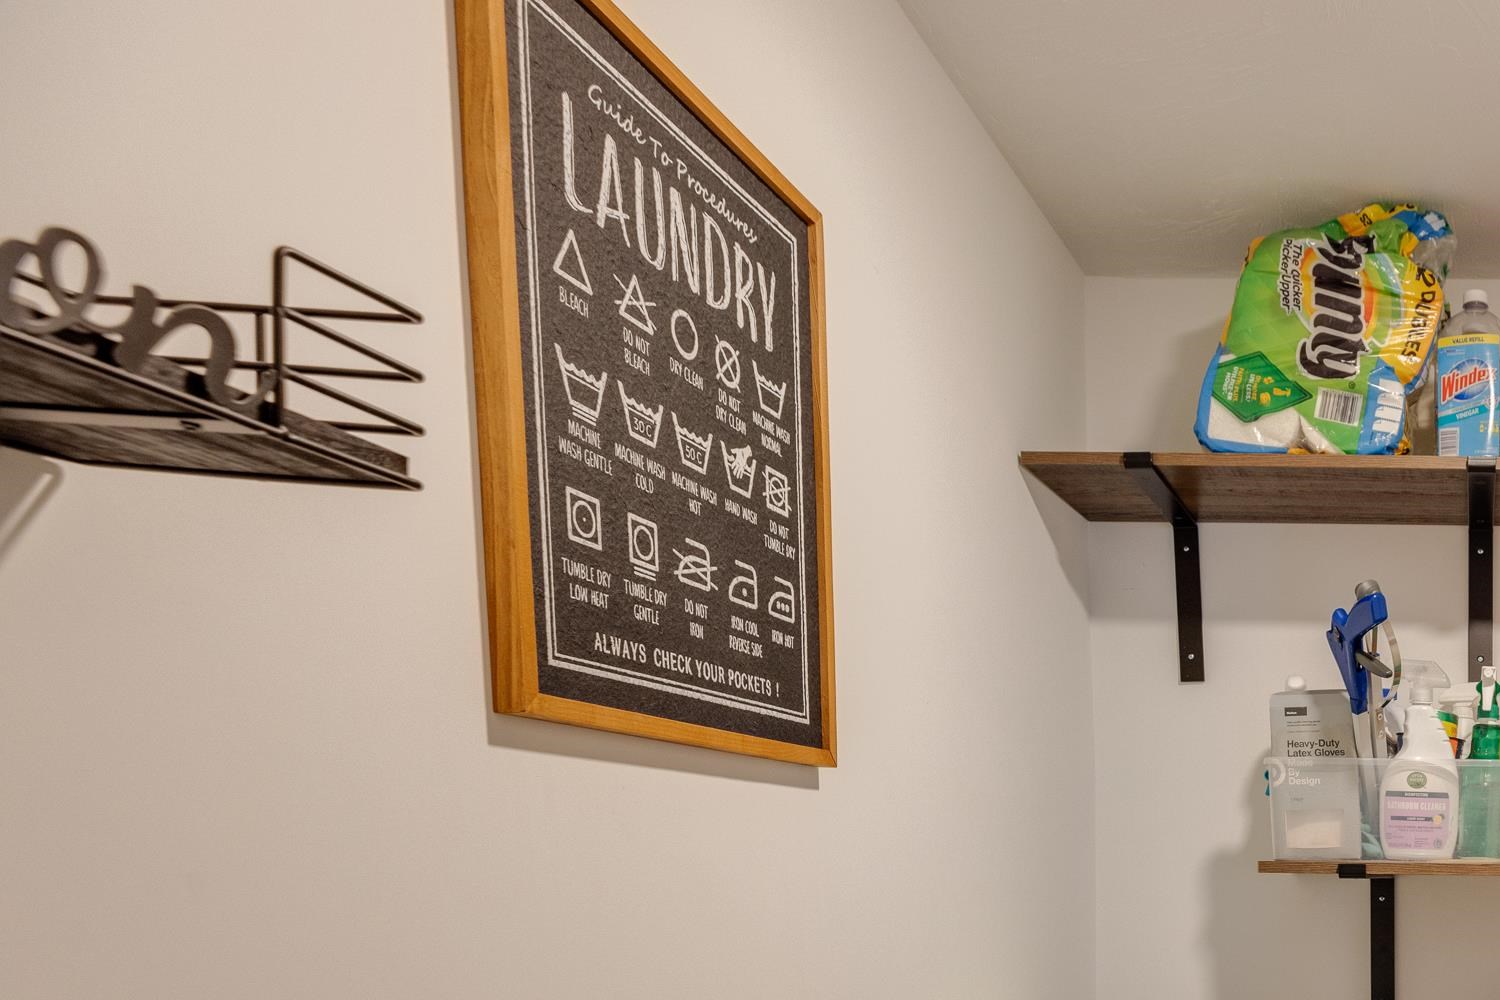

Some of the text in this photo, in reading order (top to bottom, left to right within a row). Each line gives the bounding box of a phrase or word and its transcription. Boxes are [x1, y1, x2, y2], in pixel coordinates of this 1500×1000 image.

[588, 84, 758, 244] Guide To Procedures
[561, 91, 776, 352] LAUNDRY
[559, 285, 589, 318] BLEACH
[623, 327, 650, 357] DO NOT
[624, 347, 650, 377] BLEACH
[669, 357, 704, 391] DRY CLEAN
[1441, 367, 1497, 405] Windex
[718, 388, 741, 413] DO NOT
[633, 417, 652, 437] 30 C
[715, 405, 747, 436] DRY CLEAN
[752, 410, 791, 445] MACHINE WASH
[567, 419, 601, 449] MACHINE
[761, 433, 782, 457] NORMAL
[559, 435, 613, 476] WASH GENTLE
[614, 442, 666, 480] MACHINE WASH
[685, 445, 702, 465] 50 C
[635, 473, 654, 494] COLD
[671, 471, 718, 506] MACHINE WASH
[689, 497, 702, 516] HOT
[724, 498, 758, 525] HAND WASH
[769, 520, 790, 540] DO NOT
[763, 533, 796, 560] TUMBLE DRY
[561, 557, 611, 588] TUMBLE DRY
[569, 583, 609, 609] LOW HEAT
[623, 579, 667, 607] TUMBLE DRY
[633, 604, 660, 626] GENTLE
[684, 598, 708, 619] DO NOT
[689, 622, 704, 640] IRON
[730, 615, 759, 637] IRON COOL
[771, 629, 794, 649] IRON HOT
[729, 635, 763, 658] REVERSE SIDE
[594, 632, 772, 697] ALWAYS CHECK YOUR POCKETS
[1287, 739, 1340, 749] Heavy-Duty
[1287, 748, 1346, 758] Latex Gloves
[1288, 768, 1300, 777] By
[1288, 777, 1320, 787] Design
